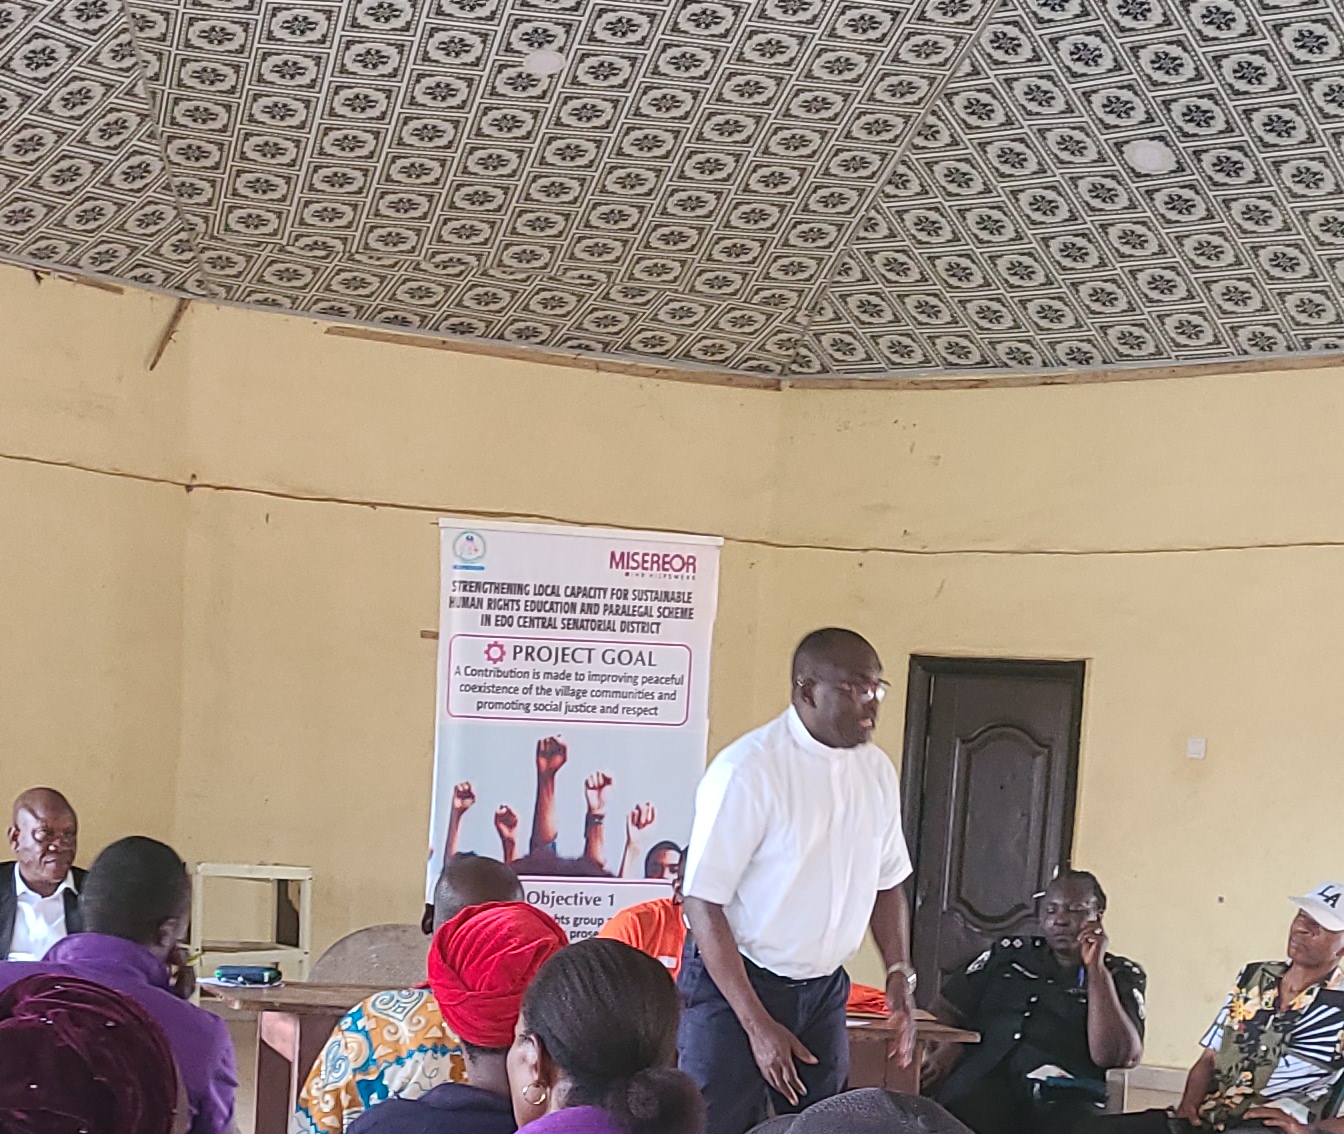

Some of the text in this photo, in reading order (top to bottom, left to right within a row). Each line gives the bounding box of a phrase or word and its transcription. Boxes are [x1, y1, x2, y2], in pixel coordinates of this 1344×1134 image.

[610, 550, 697, 574] MISEREOR
[451, 580, 693, 604] STRENGTHENING LOCAL CAPACITY FOR SUSTAINABLE
[449, 596, 694, 620] HUMAN RIGHTS EDUCATION AND PARALEGAL SCHEME
[480, 614, 661, 634] IN EDO CENTRAL SENATORIAL DISTRICT
[513, 645, 657, 667] PROJECT GOAL
[454, 666, 684, 686] A Contribution is made to improving peaceful
[459, 682, 677, 701] coexistence of the village communities and
[477, 700, 659, 717] promoting social justice and respect
[526, 890, 615, 908] Objective 1
[1317, 885, 1342, 909] LA
[573, 916, 604, 927] group
